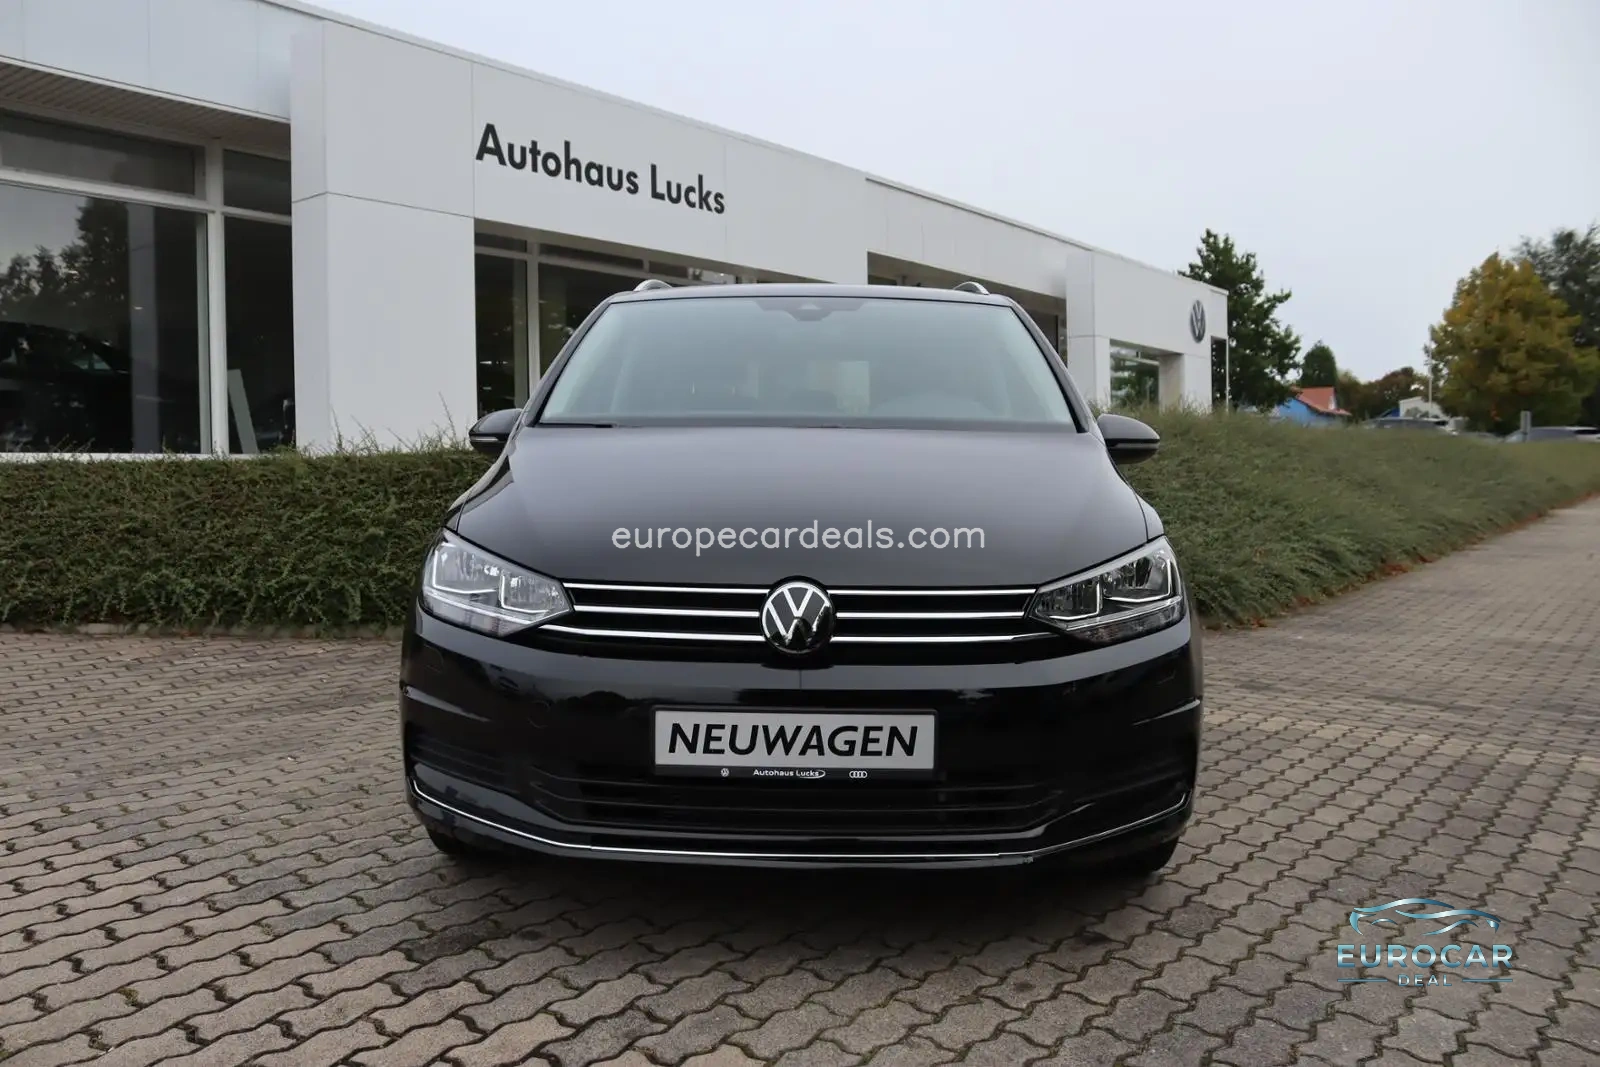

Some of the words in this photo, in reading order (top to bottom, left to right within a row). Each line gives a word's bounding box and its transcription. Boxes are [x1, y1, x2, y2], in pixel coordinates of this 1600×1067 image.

[475, 123, 639, 195] Autohaus
[650, 163, 725, 214] Lucks
[668, 723, 918, 757] NEUWAGEN
[753, 768, 794, 777] Autohaus
[795, 769, 820, 777] Lucks
